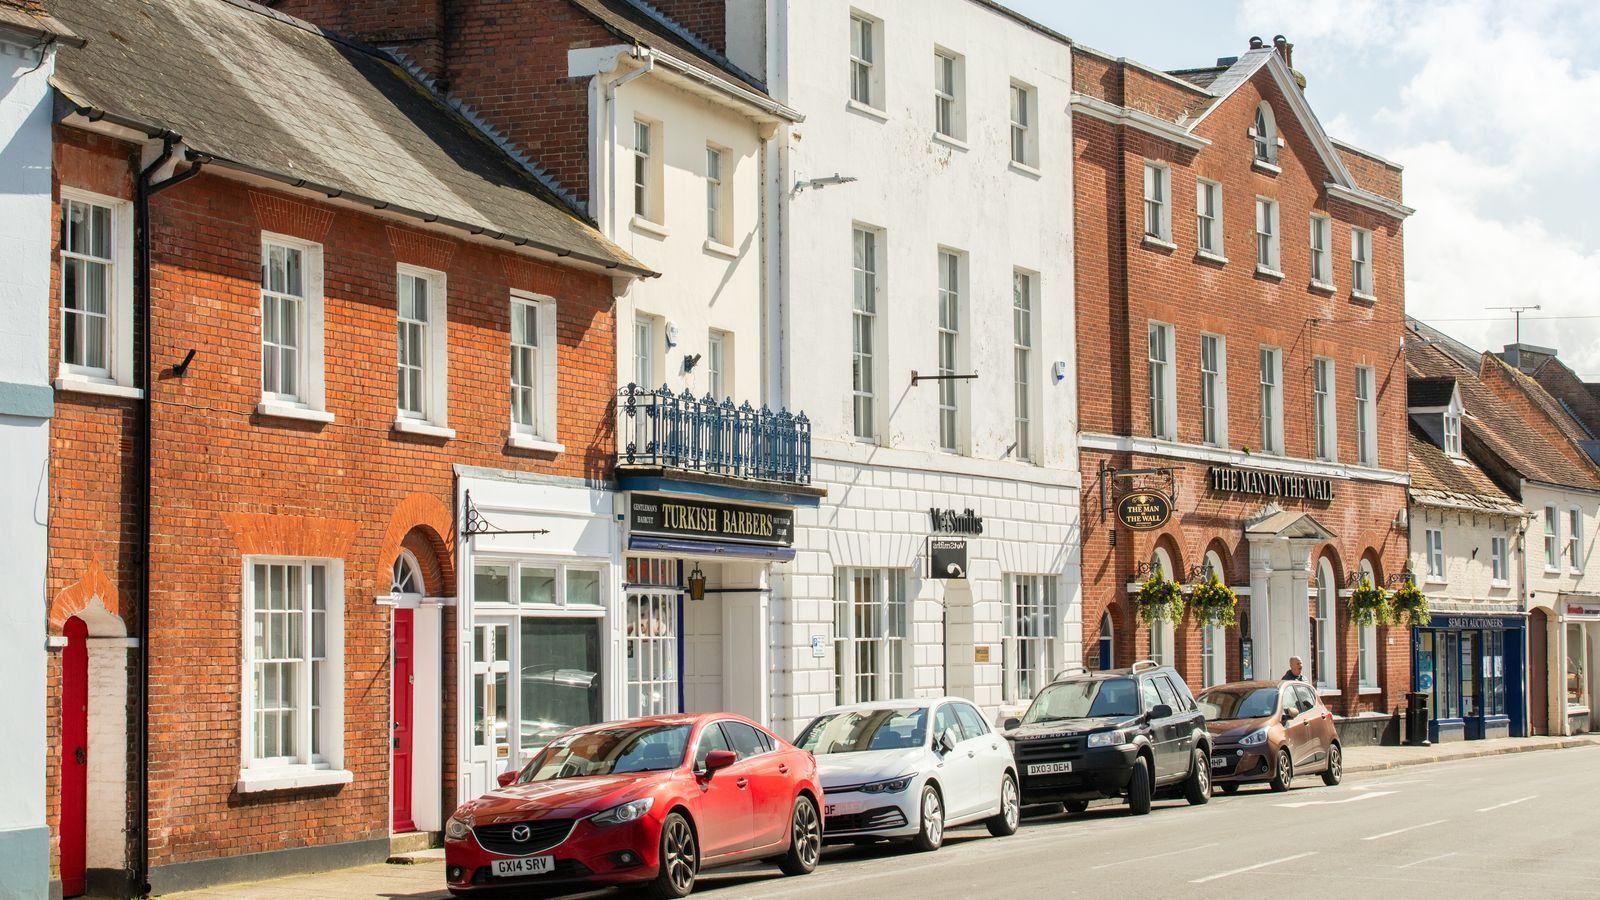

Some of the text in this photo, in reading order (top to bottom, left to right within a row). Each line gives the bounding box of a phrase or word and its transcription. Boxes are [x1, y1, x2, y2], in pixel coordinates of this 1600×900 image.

[1212, 467, 1335, 501] THE MAN IN THE WALL
[662, 503, 773, 536] TURKISH BARBERS
[1031, 764, 1052, 774] DX03
[498, 857, 547, 873] GX14 SRV
